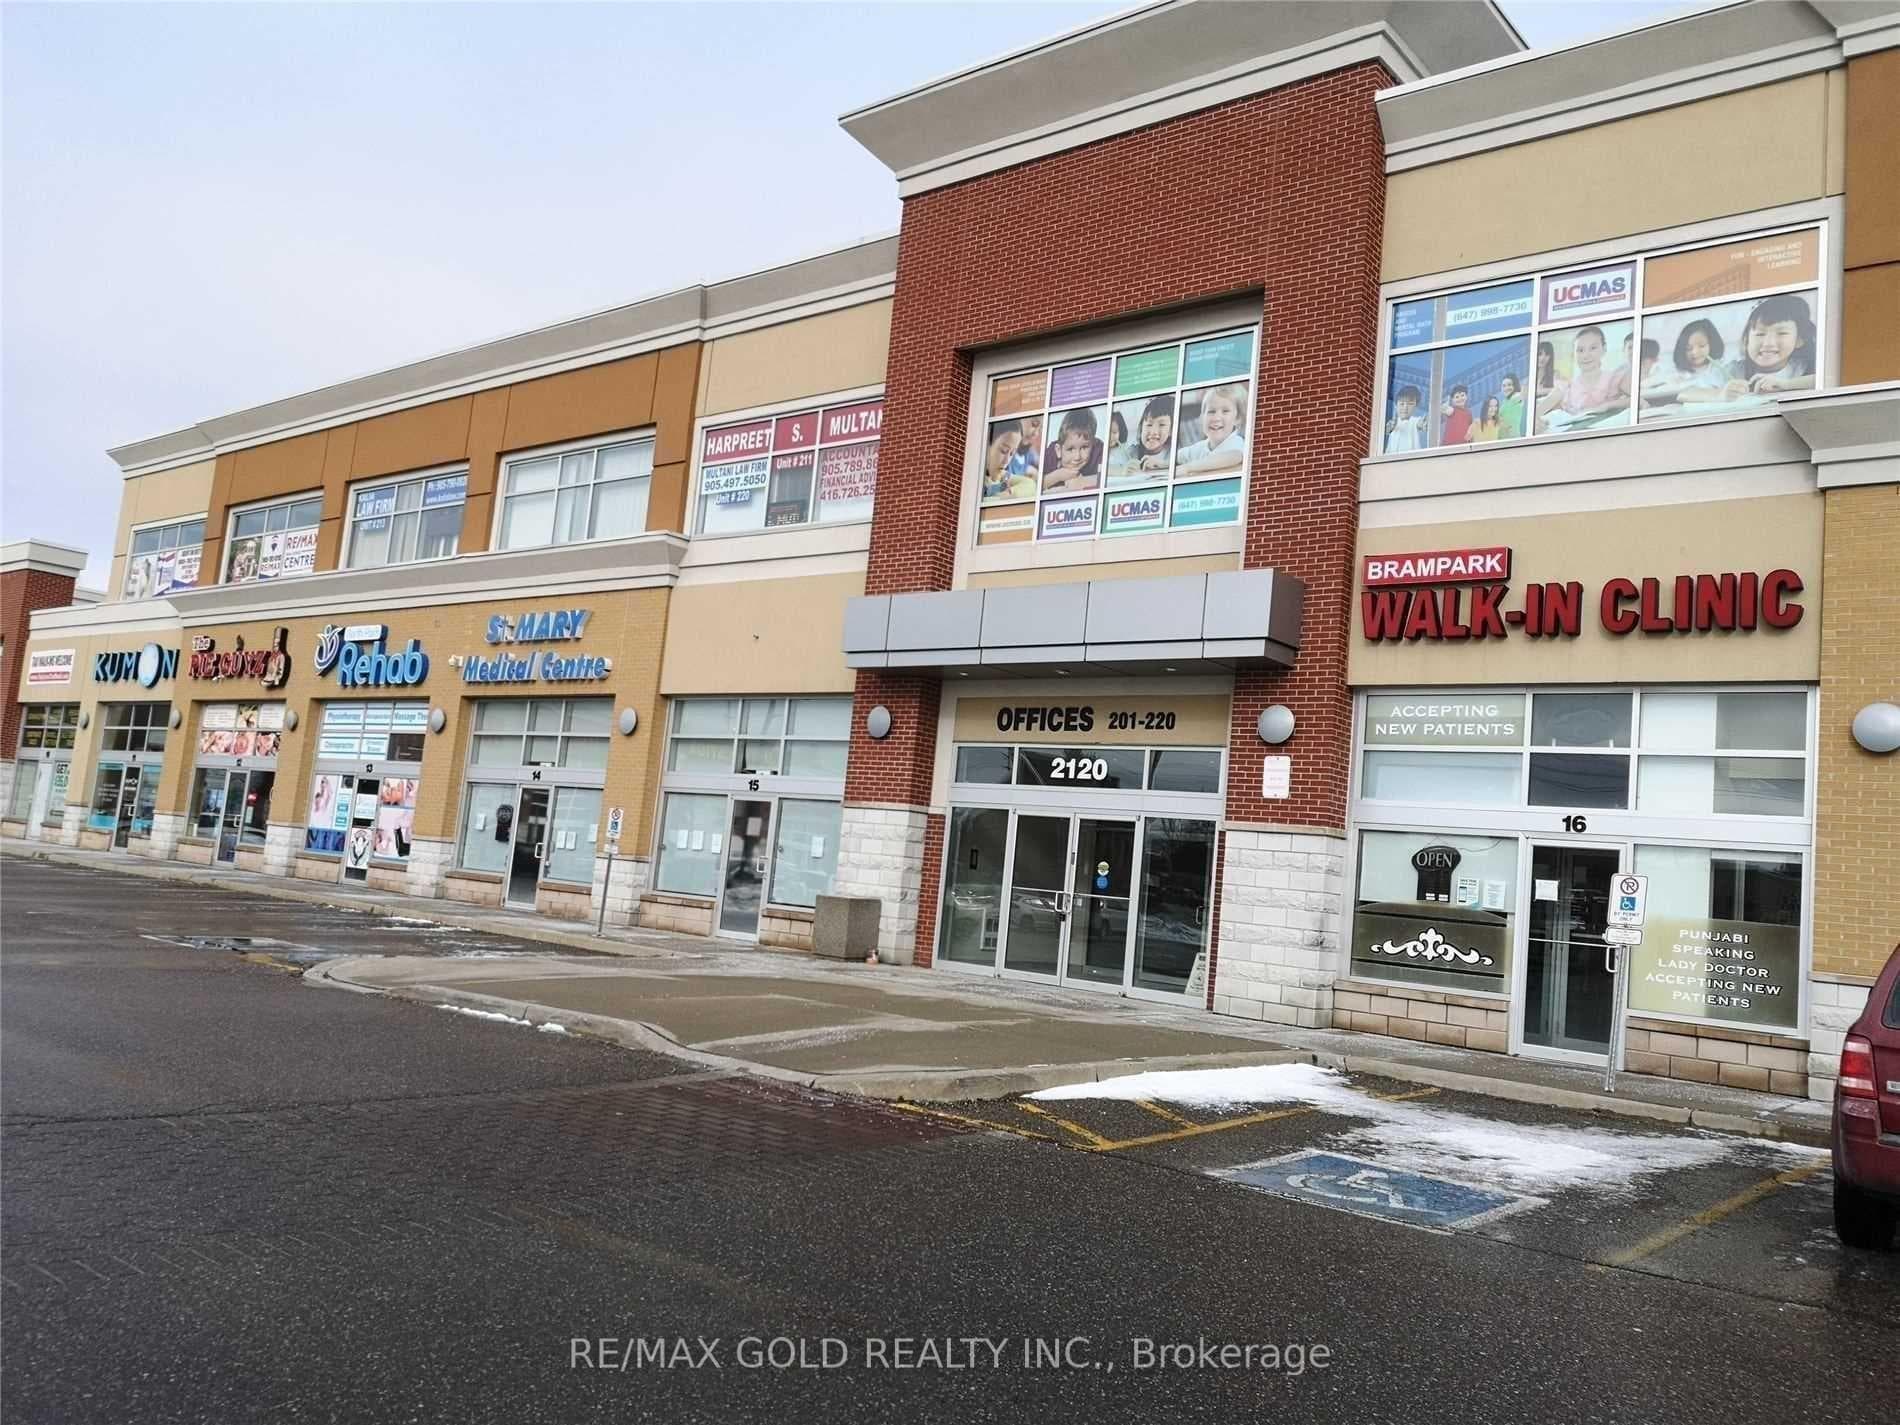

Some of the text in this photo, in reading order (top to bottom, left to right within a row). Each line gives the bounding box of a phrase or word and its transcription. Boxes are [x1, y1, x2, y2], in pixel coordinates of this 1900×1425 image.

[1554, 277, 1626, 303] UCMAS
[706, 428, 772, 456] HARPREET
[791, 423, 804, 443] S.
[706, 461, 768, 479] MULTANI LAW FIRM
[776, 456, 792, 469] Unit
[704, 474, 767, 491] 905.497.5050
[821, 474, 857, 488] FINANCIAL
[1047, 507, 1093, 523] UCMAS
[1111, 500, 1160, 517] UCMAS
[284, 553, 315, 569] CENTRE
[1367, 553, 1504, 580] BRAMPARK
[1361, 568, 1805, 641] WALK-IN CLINIC
[514, 609, 590, 642] MARY
[193, 636, 210, 651] The
[93, 642, 181, 688] KUMON
[338, 640, 428, 687] Rehab
[463, 651, 612, 682] Medical Centre
[997, 706, 1176, 732] OFFICES 201-220
[1390, 704, 1499, 718] ACCEPTING
[1375, 723, 1515, 736] NEW PATIENTS
[532, 770, 541, 781] 14
[1050, 757, 1108, 781] 2120
[748, 779, 760, 791] 15
[1562, 815, 1587, 833] 16
[1416, 851, 1453, 868] OPEN
[1679, 929, 1750, 944] PUNJABI
[1672, 944, 1755, 960] SPEAKING
[1658, 957, 1769, 978] LADY DOCTOR
[1645, 972, 1781, 996] ACCEPTING NEW
[1672, 991, 1751, 1009] PATIENTS
